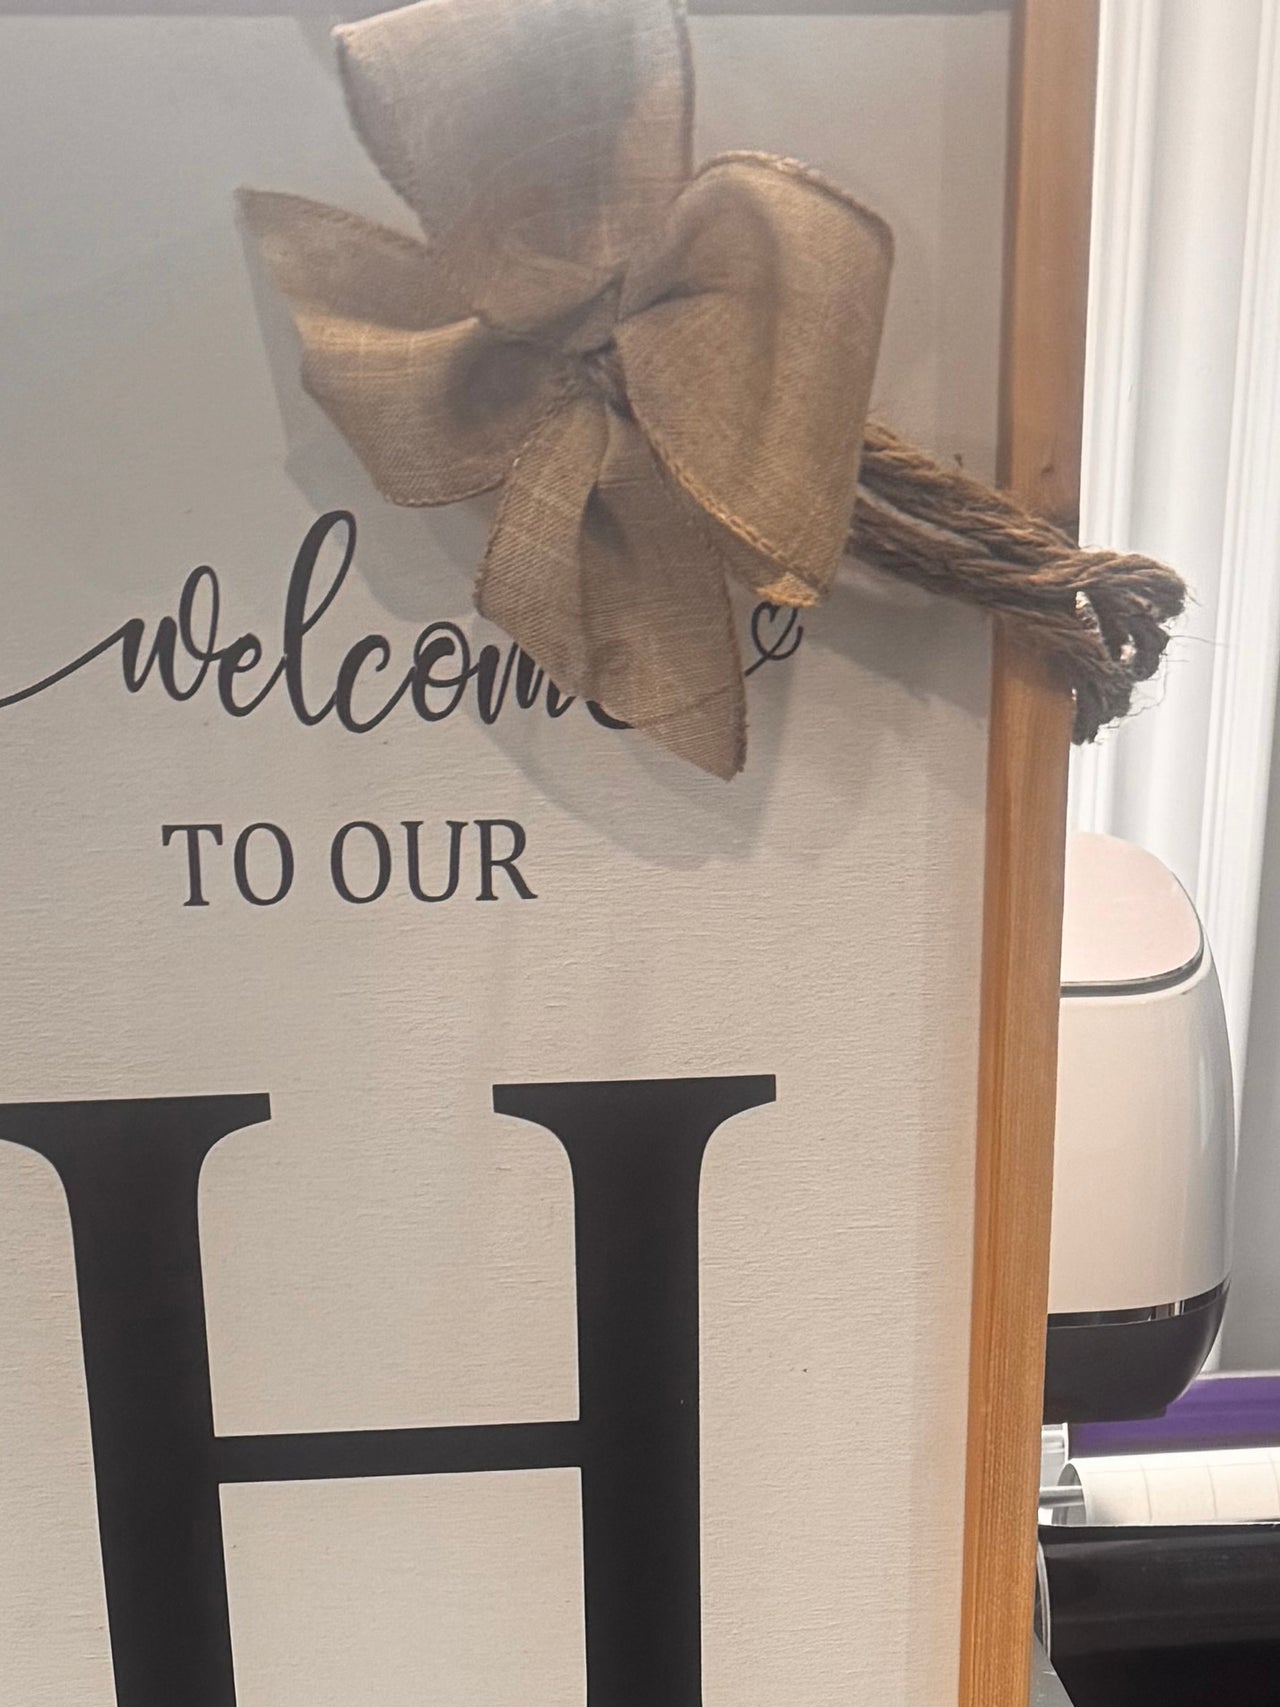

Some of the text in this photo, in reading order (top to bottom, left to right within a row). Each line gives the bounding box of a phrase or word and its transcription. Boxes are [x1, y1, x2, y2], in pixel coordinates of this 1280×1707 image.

[115, 508, 638, 735] welcom
[161, 818, 539, 908] TO OUR
